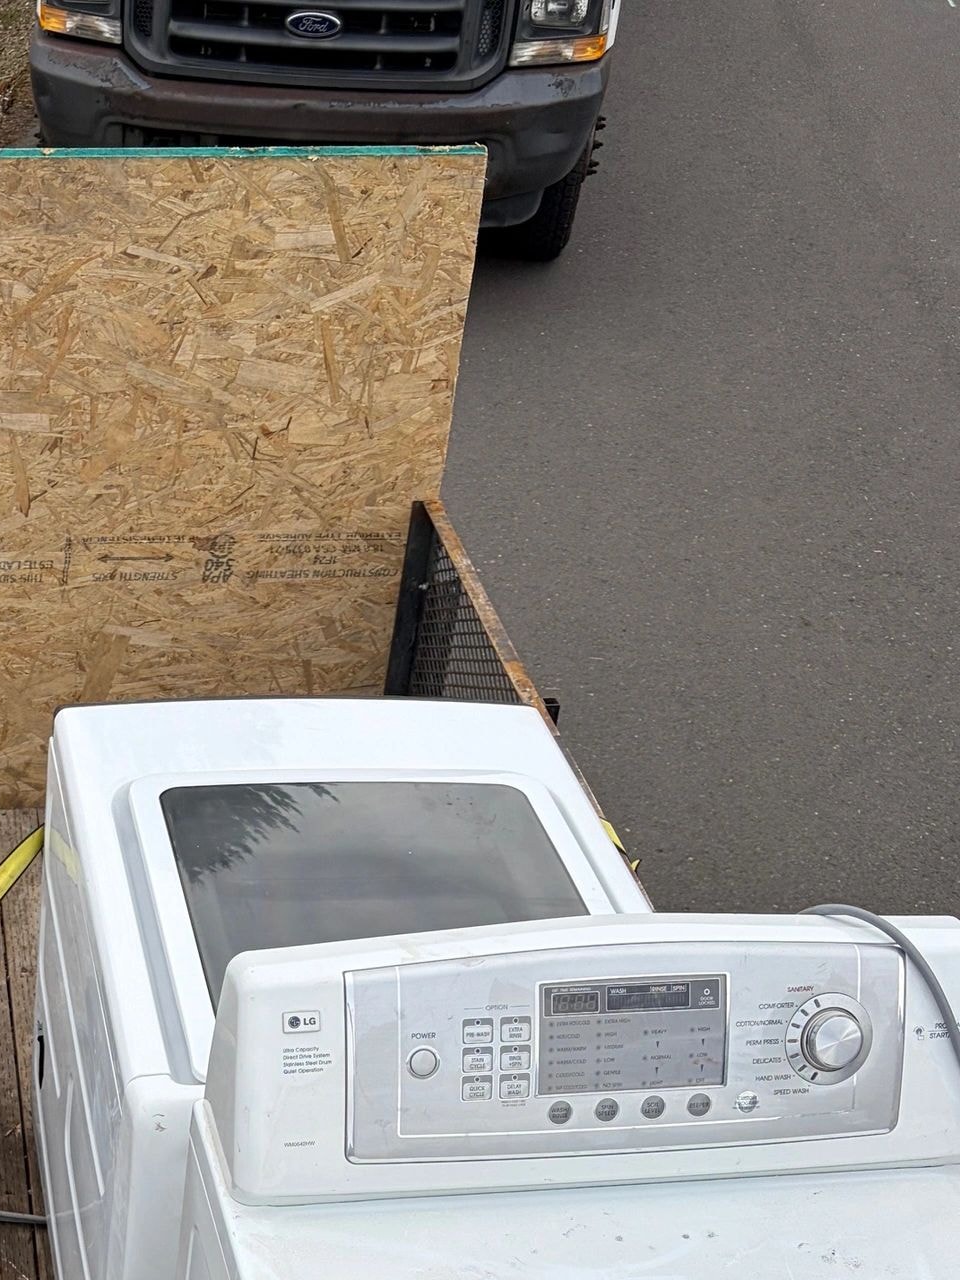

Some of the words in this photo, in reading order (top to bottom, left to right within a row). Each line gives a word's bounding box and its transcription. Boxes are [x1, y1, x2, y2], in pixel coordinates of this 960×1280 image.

[298, 16, 329, 32] Ford
[24, 560, 54, 569] ESTE
[120, 572, 178, 582] STRENGTH
[201, 570, 233, 584] APA
[246, 569, 309, 579] SHEATHING
[313, 568, 398, 578] CONSTRUCTION
[303, 1017, 316, 1025] LG
[736, 1019, 783, 1027] COTTON/NORMAL
